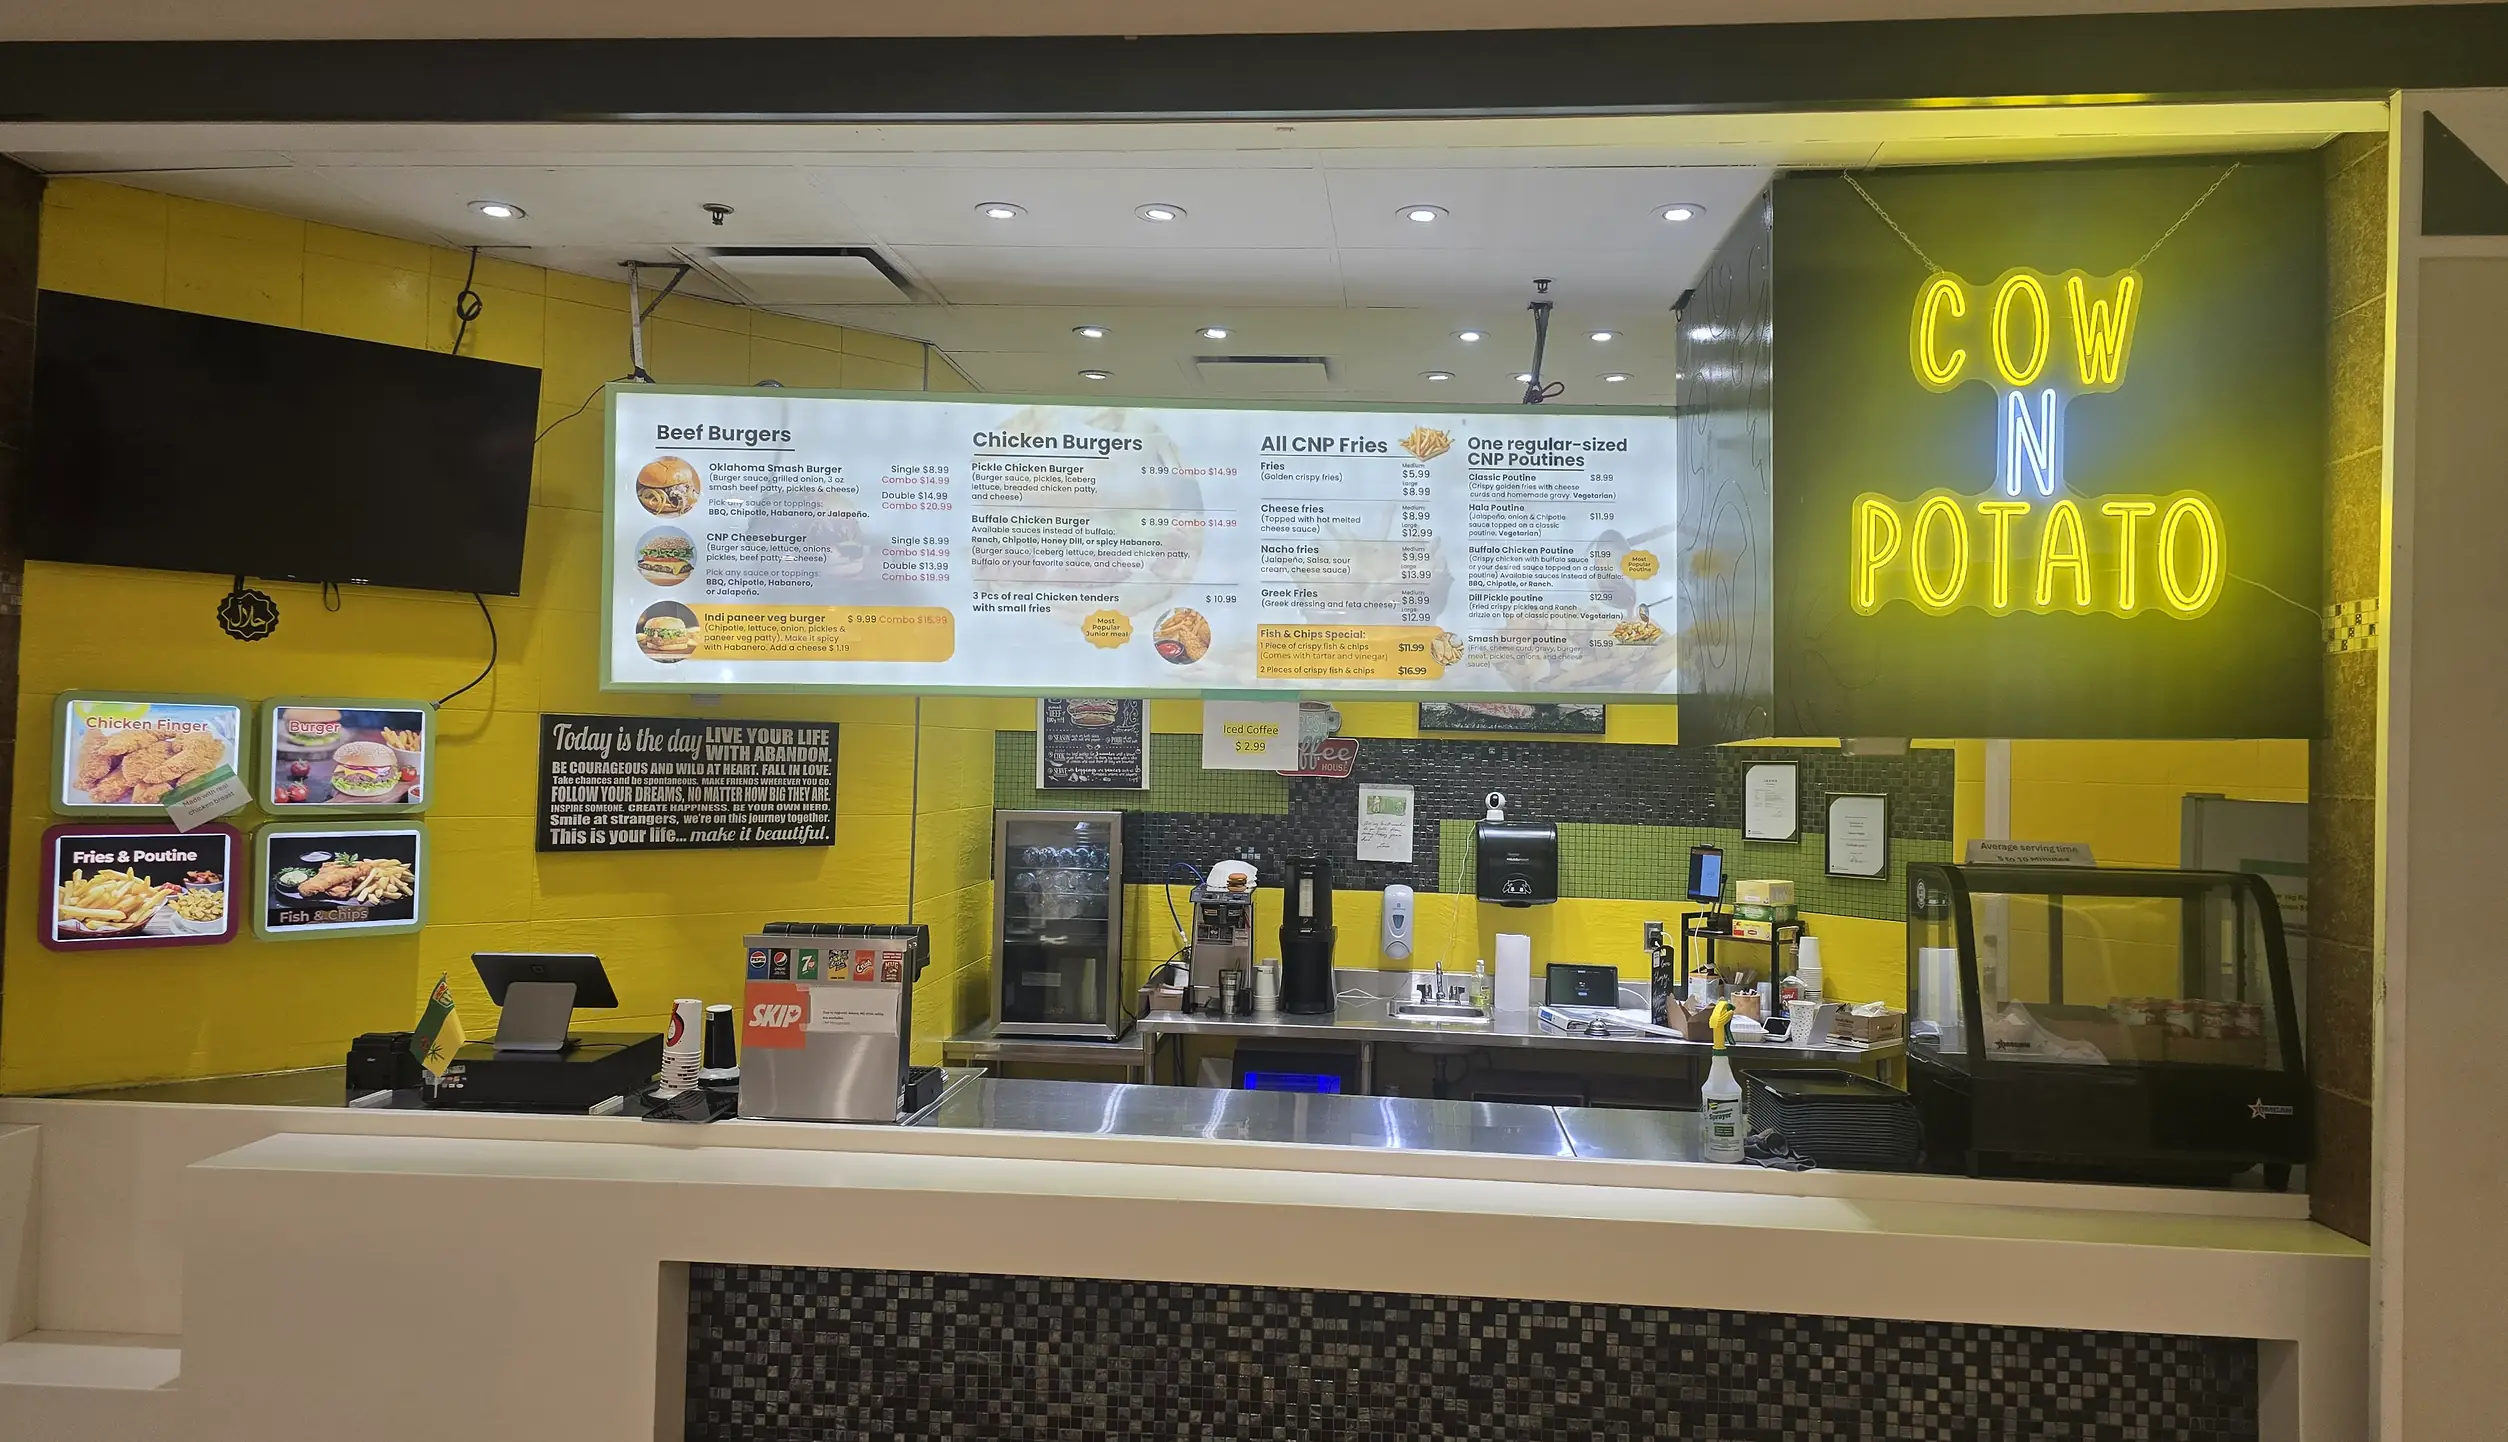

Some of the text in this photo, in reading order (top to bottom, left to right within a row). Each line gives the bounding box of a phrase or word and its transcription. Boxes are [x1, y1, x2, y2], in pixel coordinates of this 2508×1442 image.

[1919, 274, 2135, 386] COW
[657, 423, 791, 447] Beef Burgers
[972, 430, 1142, 455] Chicken Burgers
[1260, 435, 1387, 453] All CNP Fries
[1467, 436, 1627, 454] One regular-sized
[2006, 388, 2057, 497] N
[1260, 461, 1284, 471] Fries
[1467, 452, 1584, 466] CNP Poutines
[708, 462, 842, 476] Oklahoma Smash Burger
[891, 464, 949, 475] Single $8.99
[971, 462, 1084, 475] Pickle Chicken Burger
[1402, 469, 1430, 478] $5.99
[1468, 473, 1500, 481] Classic
[1260, 503, 1324, 513] Cheese fries
[971, 514, 1090, 527] Buffalo Chicken Burger
[706, 532, 806, 544] CNP Cheeseburger
[1260, 544, 1318, 554] Nacho fries
[1858, 495, 2218, 610] POTATO
[972, 591, 1119, 601] 3 Pcs of real Chicken tenders
[1261, 588, 1318, 598] Greek Fries
[230, 600, 266, 628] حلال
[972, 602, 1051, 612] with small fries
[704, 611, 825, 626] Indi paneer veg burger
[1260, 629, 1280, 638] Fish
[1294, 630, 1323, 640] Chips
[1325, 630, 1366, 640] Special:
[86, 716, 209, 734] Chicken Finger
[289, 720, 341, 734] Burger
[1223, 725, 1279, 735] Iced Coffee
[553, 723, 702, 760] Today is the day
[705, 726, 829, 745] LIVE YOUR LIFE
[705, 744, 832, 762] WITH ABANDON.
[1236, 742, 1266, 751] $ 2.99
[552, 761, 831, 775] BE COURAGEOUS AND WILD AT HEART. FALL IN LOVE.
[1322, 764, 1348, 772] HOUSE
[552, 775, 574, 784] Take
[574, 775, 612, 784] chances
[613, 776, 630, 784] and
[630, 776, 642, 784] be
[643, 776, 698, 785] spontaneous.
[182, 784, 229, 807] Made with real
[551, 785, 830, 803] FOLLOW YOUR DREAMS, NO MATTER HOW BIG THEY ARE.
[188, 791, 235, 816] chicken breast
[550, 804, 583, 812] INSPIRE
[584, 804, 624, 812] SOMEONE.
[669, 803, 729, 811] HAPPINESS.
[550, 812, 830, 825] Smile at strangers, we're on this journey together.
[550, 824, 829, 844] This is your life... make it beautiful.
[1981, 842, 2018, 851] Average
[2020, 844, 2054, 853] serving
[73, 848, 198, 864] Fries & Poutine
[279, 908, 368, 923] Fish & Chips
[749, 1004, 802, 1028] SKIP
[1709, 1113, 1732, 1121] Sprayer
